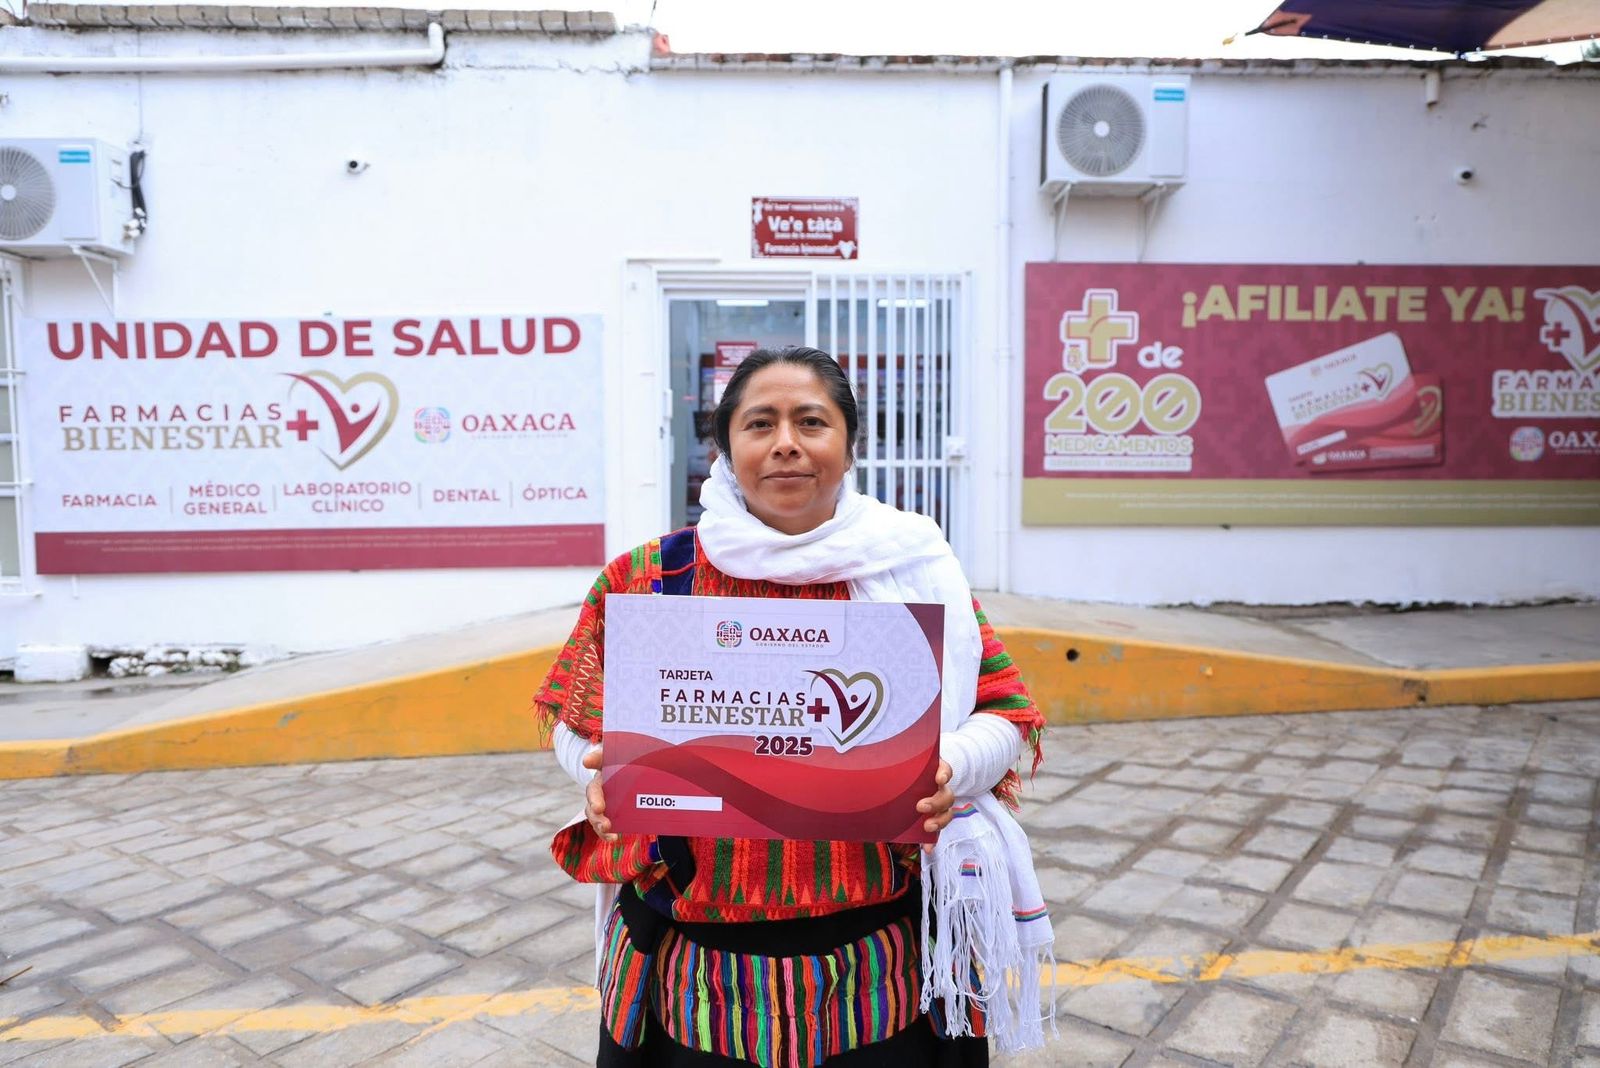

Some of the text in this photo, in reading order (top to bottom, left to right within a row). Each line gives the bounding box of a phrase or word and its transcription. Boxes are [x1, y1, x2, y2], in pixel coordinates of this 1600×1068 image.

[767, 215, 804, 232] Ve'e
[1181, 285, 1526, 328] ¡AFILIATE YA!
[46, 317, 581, 361] UNIDAD DE SALUD
[1137, 341, 1184, 369] de
[1043, 372, 1202, 435] 200
[59, 403, 282, 423] FARMACIAS
[462, 413, 576, 433] OAXACA
[61, 424, 283, 451] BIENESTAR
[1047, 436, 1193, 454] MEDICAMENTOS
[1549, 430, 1600, 448] OAX
[188, 481, 260, 498] MÉDICO
[283, 481, 412, 496] LABORATORIO
[433, 489, 500, 502] DENTAL
[522, 483, 588, 501] ÓPTICA
[62, 494, 157, 508] FARMACIA
[184, 501, 267, 515] GENERAL
[312, 496, 384, 513] CLÍNICO
[749, 627, 830, 643] OAXACA
[659, 669, 713, 681] TARJETA
[660, 688, 806, 706] FARMACIAS
[660, 704, 805, 727] BIENESTAR
[755, 735, 814, 756] 2025
[640, 796, 676, 807] FOLIO:
